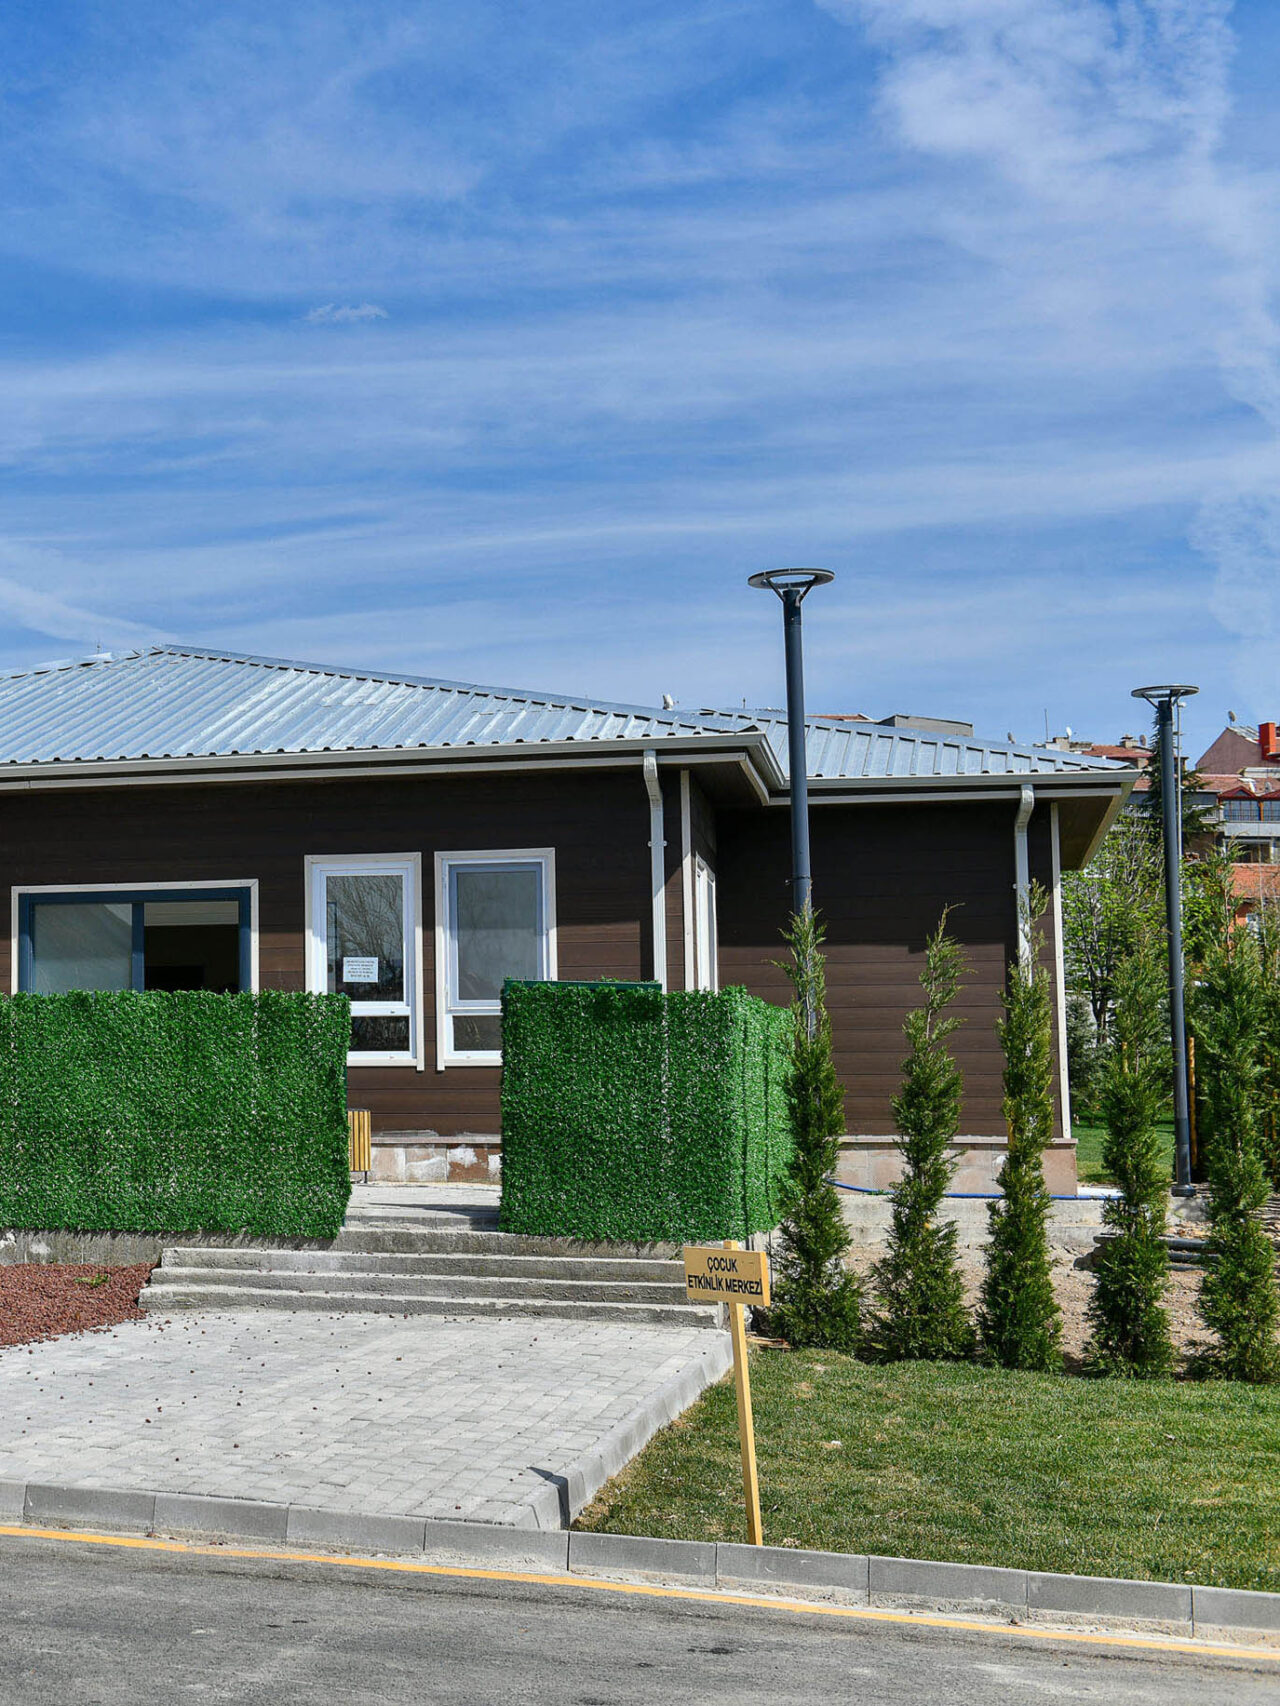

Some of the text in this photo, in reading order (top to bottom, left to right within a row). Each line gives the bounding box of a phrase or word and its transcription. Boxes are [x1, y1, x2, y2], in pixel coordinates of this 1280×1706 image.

[707, 1257, 738, 1273] ÇOCUK
[687, 1273, 763, 1295] ETKİNLİK MERKEZİ
